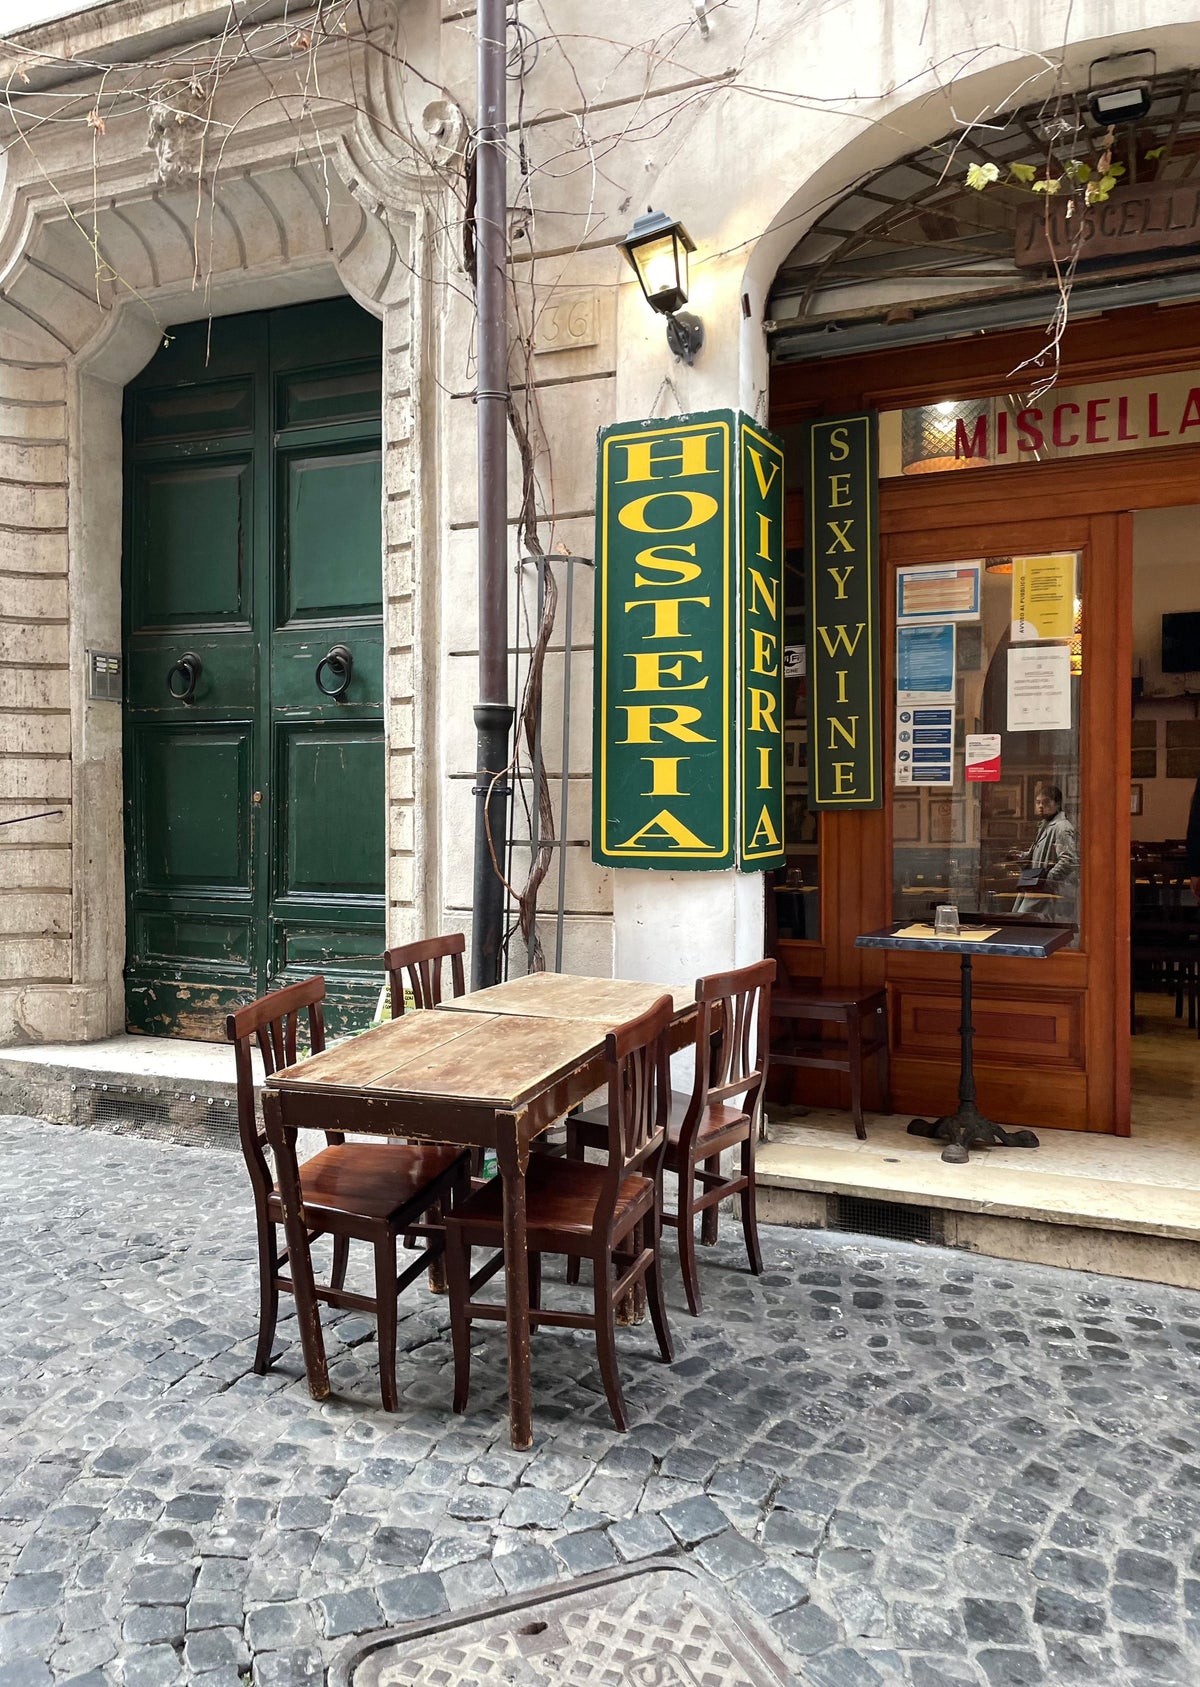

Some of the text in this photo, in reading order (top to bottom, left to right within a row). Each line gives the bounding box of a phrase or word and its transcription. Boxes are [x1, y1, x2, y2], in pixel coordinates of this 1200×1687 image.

[543, 303, 588, 342] 36
[613, 432, 720, 850] HOSTERIA
[746, 445, 781, 849] VINERIA
[816, 426, 867, 795] SEXY WINE
